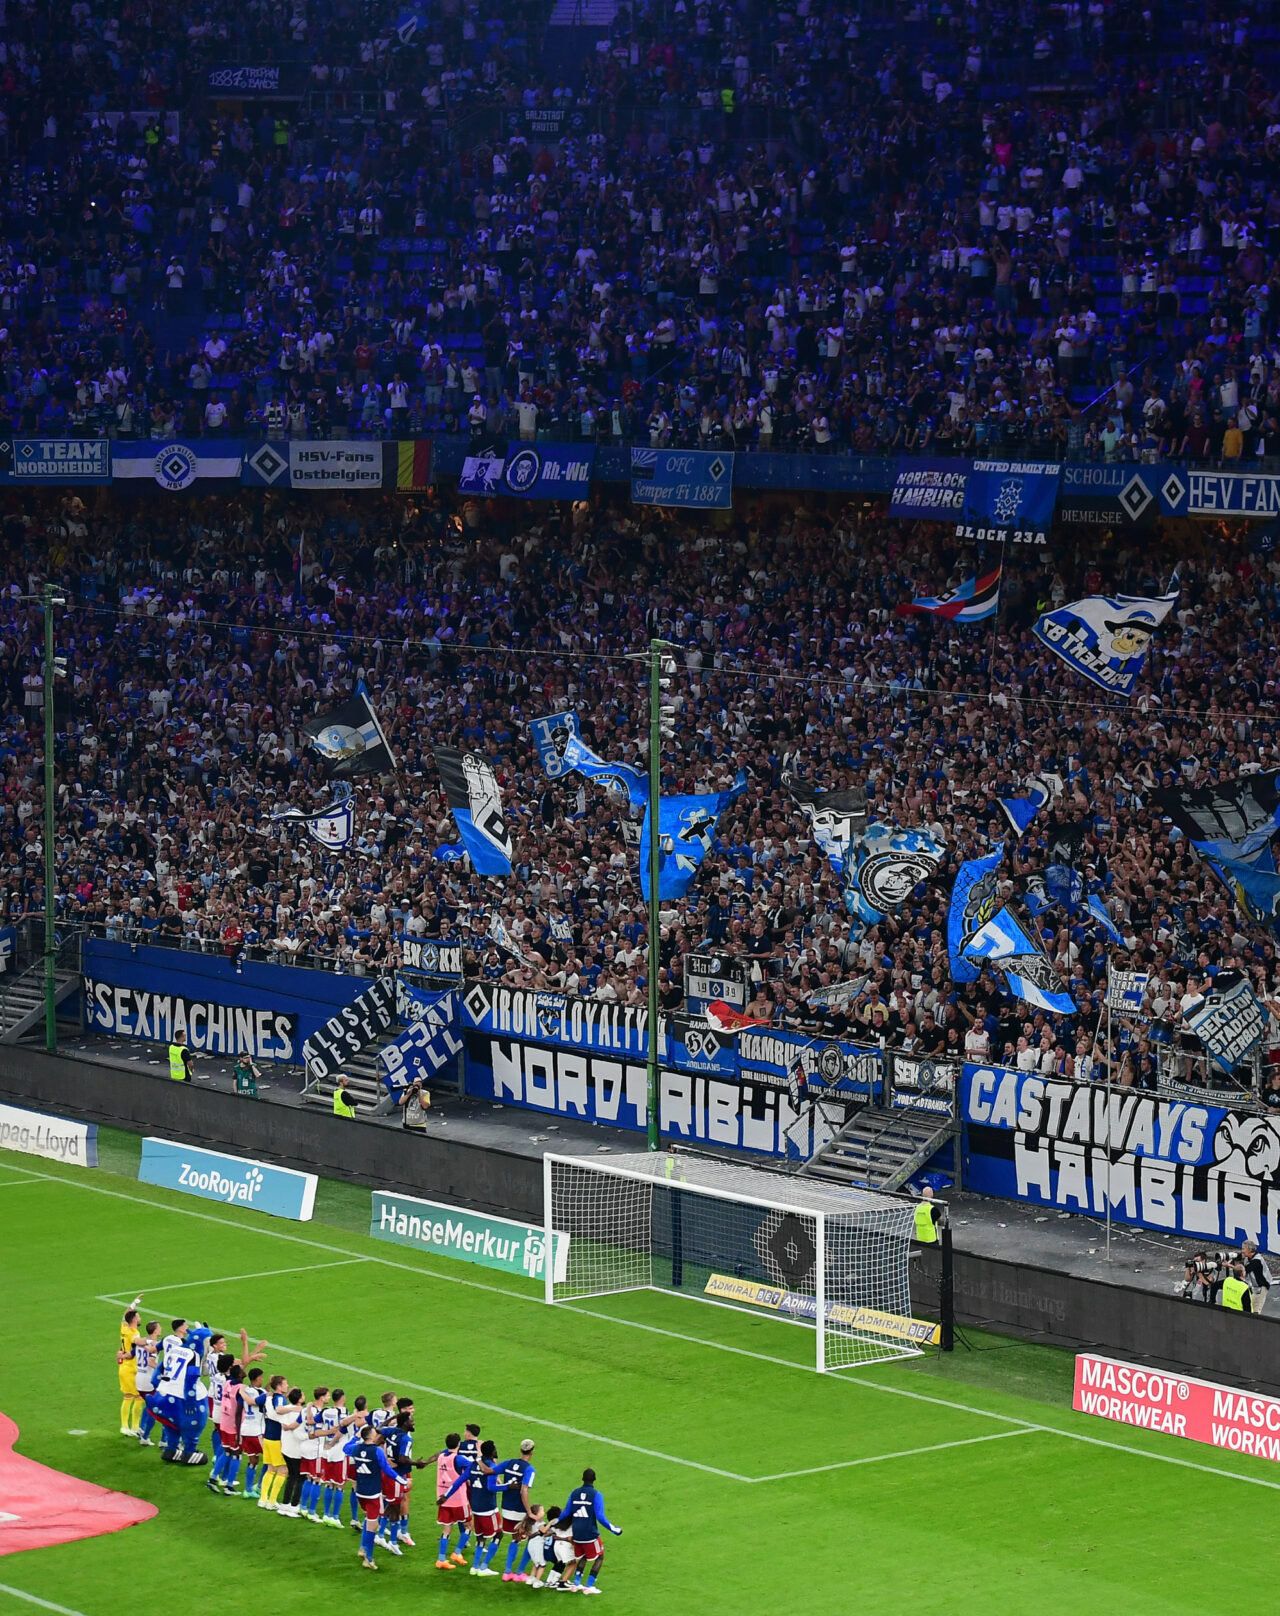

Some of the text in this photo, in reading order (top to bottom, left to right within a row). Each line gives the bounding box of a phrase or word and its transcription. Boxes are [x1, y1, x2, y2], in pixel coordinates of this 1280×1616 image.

[40, 441, 103, 460] TEAM
[299, 450, 374, 463] HSV-Fans
[17, 461, 102, 475] NORDHEIDE
[293, 469, 381, 483] Ostbelgien
[541, 460, 591, 481] Rh.-Wd.
[973, 460, 1061, 476] UNITED FAMILY HH
[1064, 467, 1125, 487] SCHOLLI
[166, 481, 183, 489] HSV
[634, 480, 674, 501] Semper
[694, 484, 725, 502] 1887
[1189, 477, 1234, 509] HSV
[891, 487, 966, 509] HAMBURG
[1061, 509, 1123, 525] DIEMELSEE
[955, 525, 1048, 545] BLOCK 23A
[95, 982, 294, 1060] SEXMACHINES
[301, 976, 395, 1061] KLOSTER
[491, 985, 538, 1037] IRON
[560, 997, 649, 1053] LOYALTY
[1195, 988, 1255, 1043] SEKTION
[380, 991, 455, 1073] B-JAY
[1207, 1002, 1261, 1058] STADION
[967, 1068, 1212, 1166] CASTAWAYS
[178, 1162, 256, 1202] ZooRoyal
[380, 1203, 521, 1263] HanseMerkur
[710, 1279, 781, 1306] ADMIRAL BET
[858, 1312, 906, 1336] ADMIRAL
[1080, 1389, 1187, 1437] WORKWEAR
